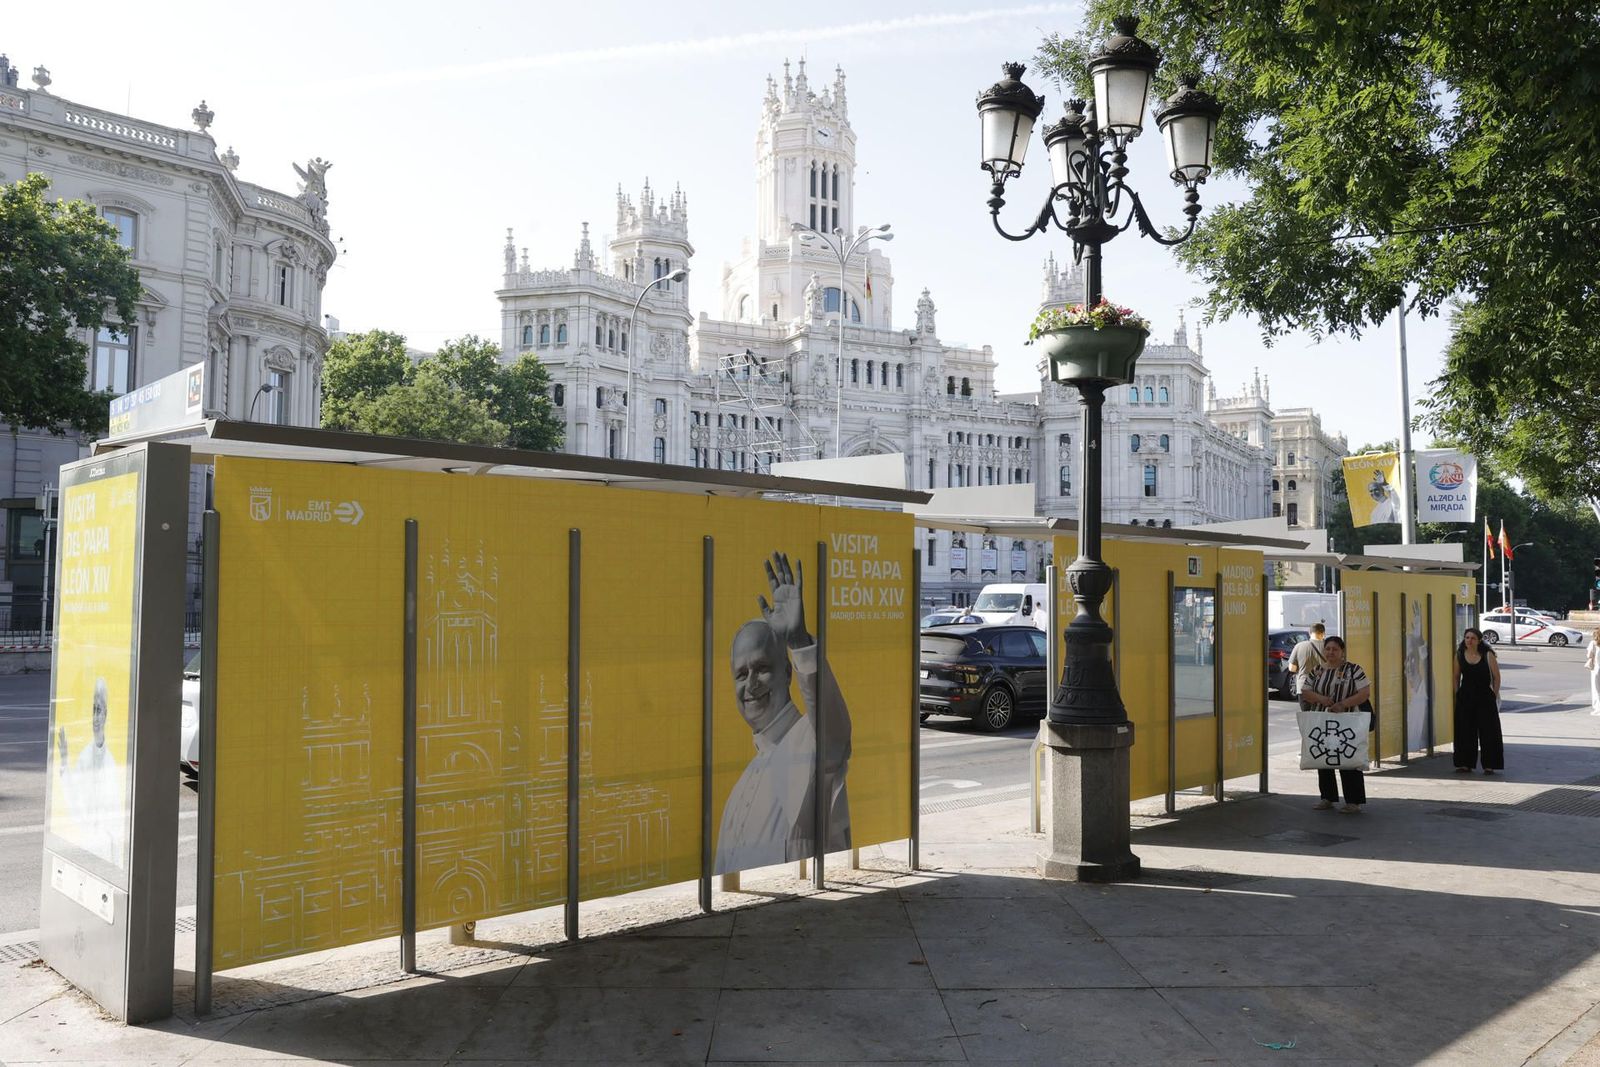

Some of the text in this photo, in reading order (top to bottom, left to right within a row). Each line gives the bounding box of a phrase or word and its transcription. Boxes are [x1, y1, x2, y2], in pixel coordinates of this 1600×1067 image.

[1347, 458, 1374, 471] LEÓN
[308, 500, 331, 511] EMT
[1427, 494, 1467, 502] ALZAD LA
[65, 492, 96, 523] VISITA
[1430, 503, 1465, 513] MIRADA
[285, 509, 331, 522] MADRID
[83, 525, 111, 556] PAPA
[830, 533, 878, 554] VISITA
[830, 558, 902, 580] DEL PAPA
[1223, 565, 1254, 582] MADRID
[64, 562, 111, 595] LEÓN XIV
[831, 581, 904, 607] LEÓN XIV
[1237, 583, 1243, 597] 6
[1243, 583, 1254, 597] AL
[1255, 583, 1261, 598] 9
[1223, 600, 1247, 615] JUNIO
[830, 610, 855, 621] MADRID
[887, 611, 905, 620] JUNIO
